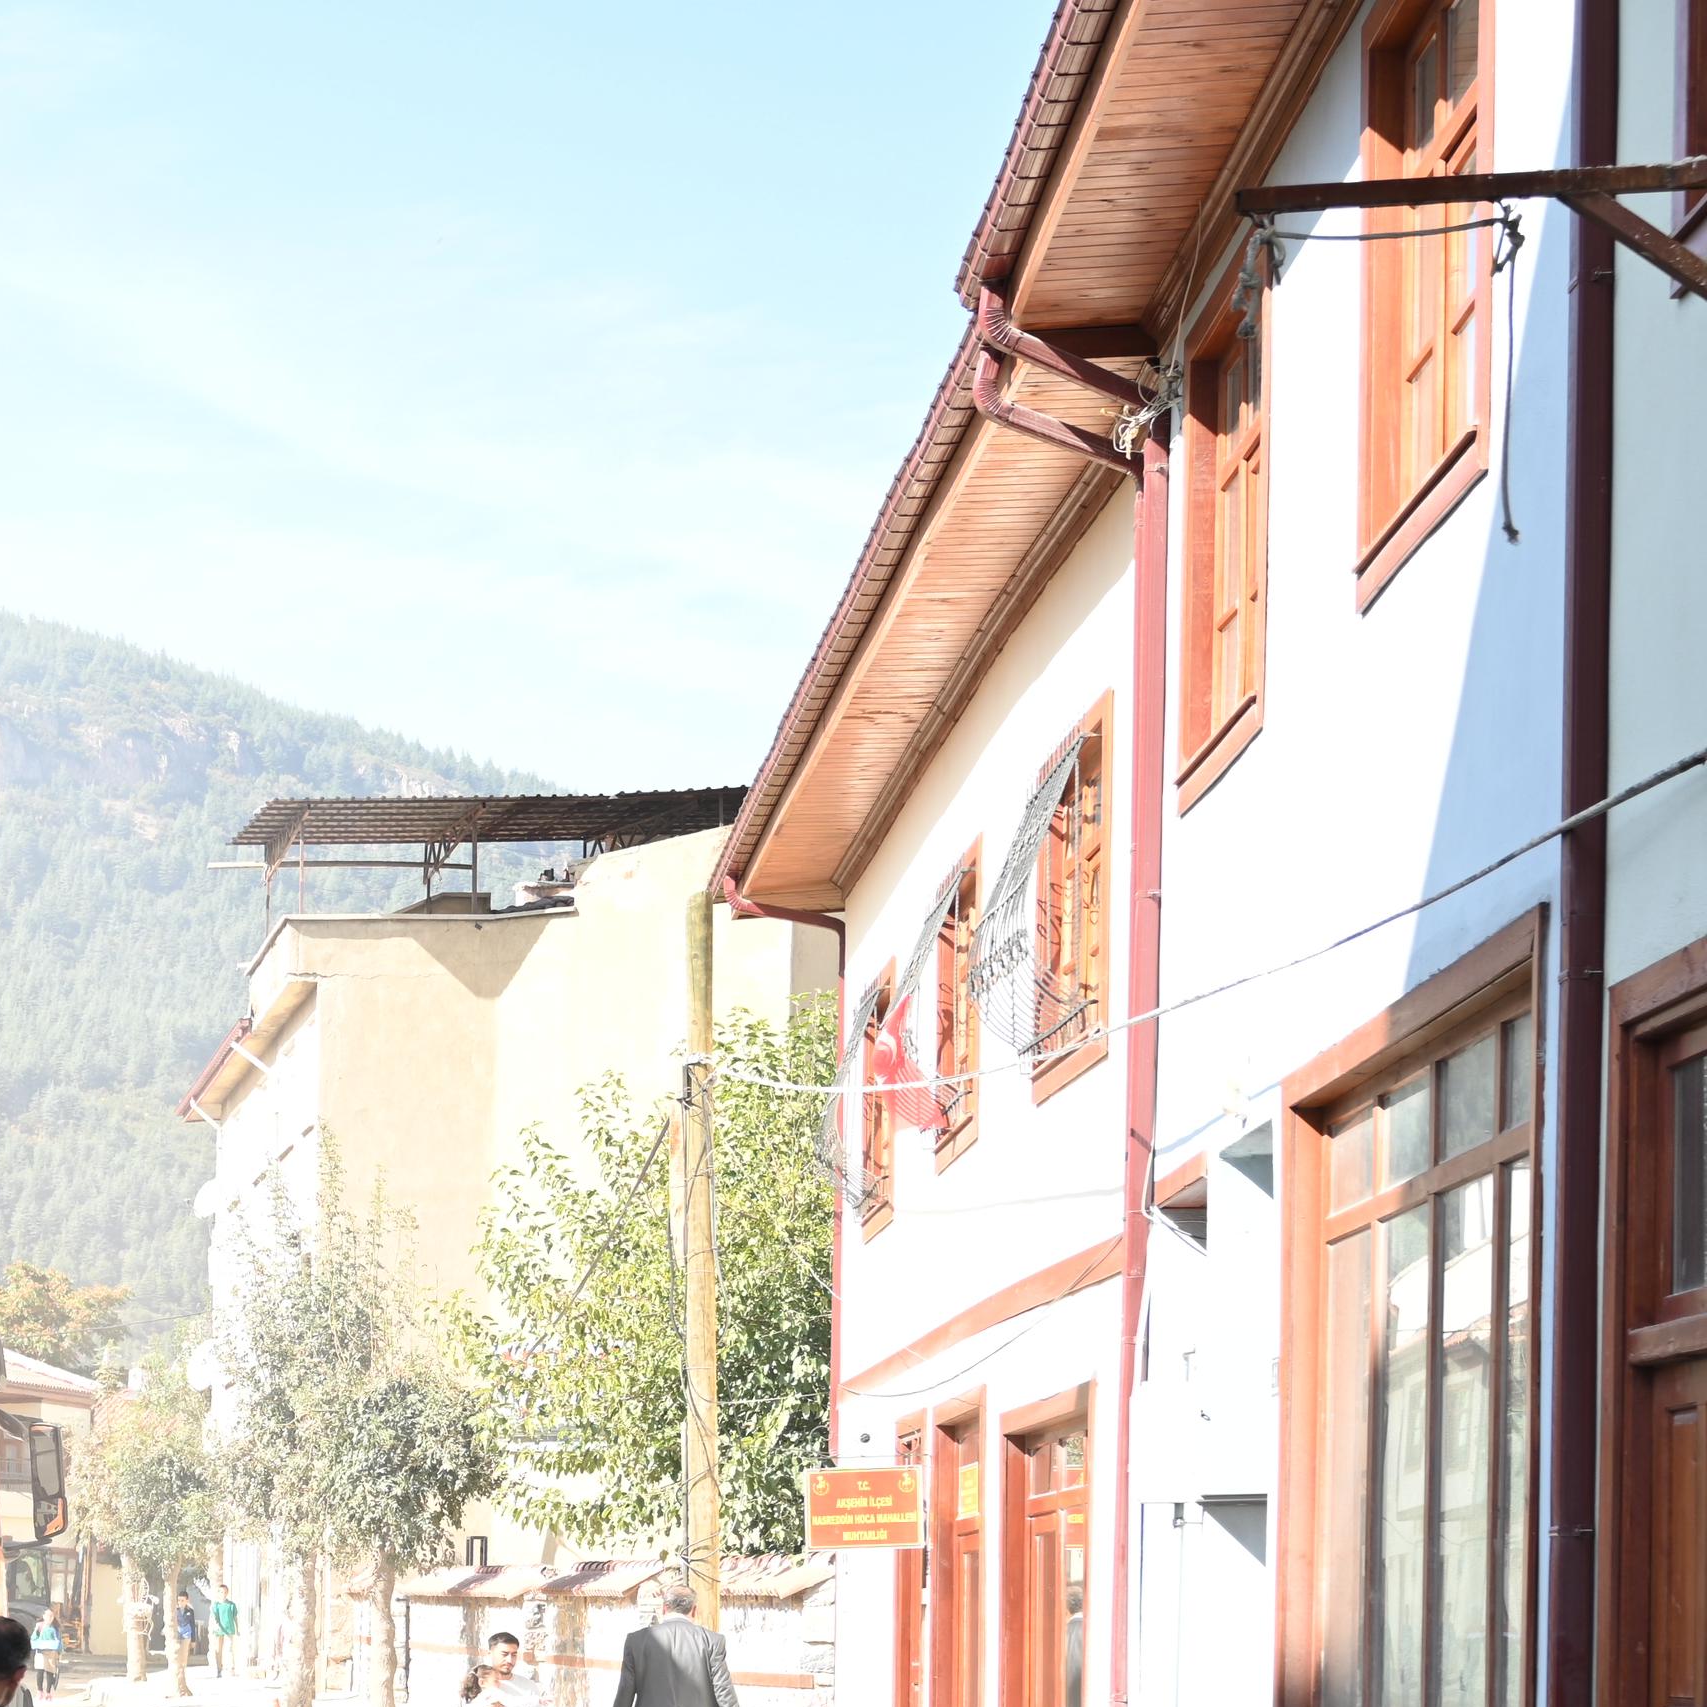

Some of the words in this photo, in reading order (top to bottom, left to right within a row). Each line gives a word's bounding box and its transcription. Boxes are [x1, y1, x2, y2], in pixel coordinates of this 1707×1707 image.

[836, 1496, 867, 1509] AKŞEHİR
[869, 1495, 892, 1508] İLÇESİ
[812, 1514, 853, 1525] NASREDDİN
[854, 1514, 875, 1524] HOCA
[877, 1512, 917, 1523] MAHALLESİ
[843, 1529, 887, 1540] MUHTARLIĞI
